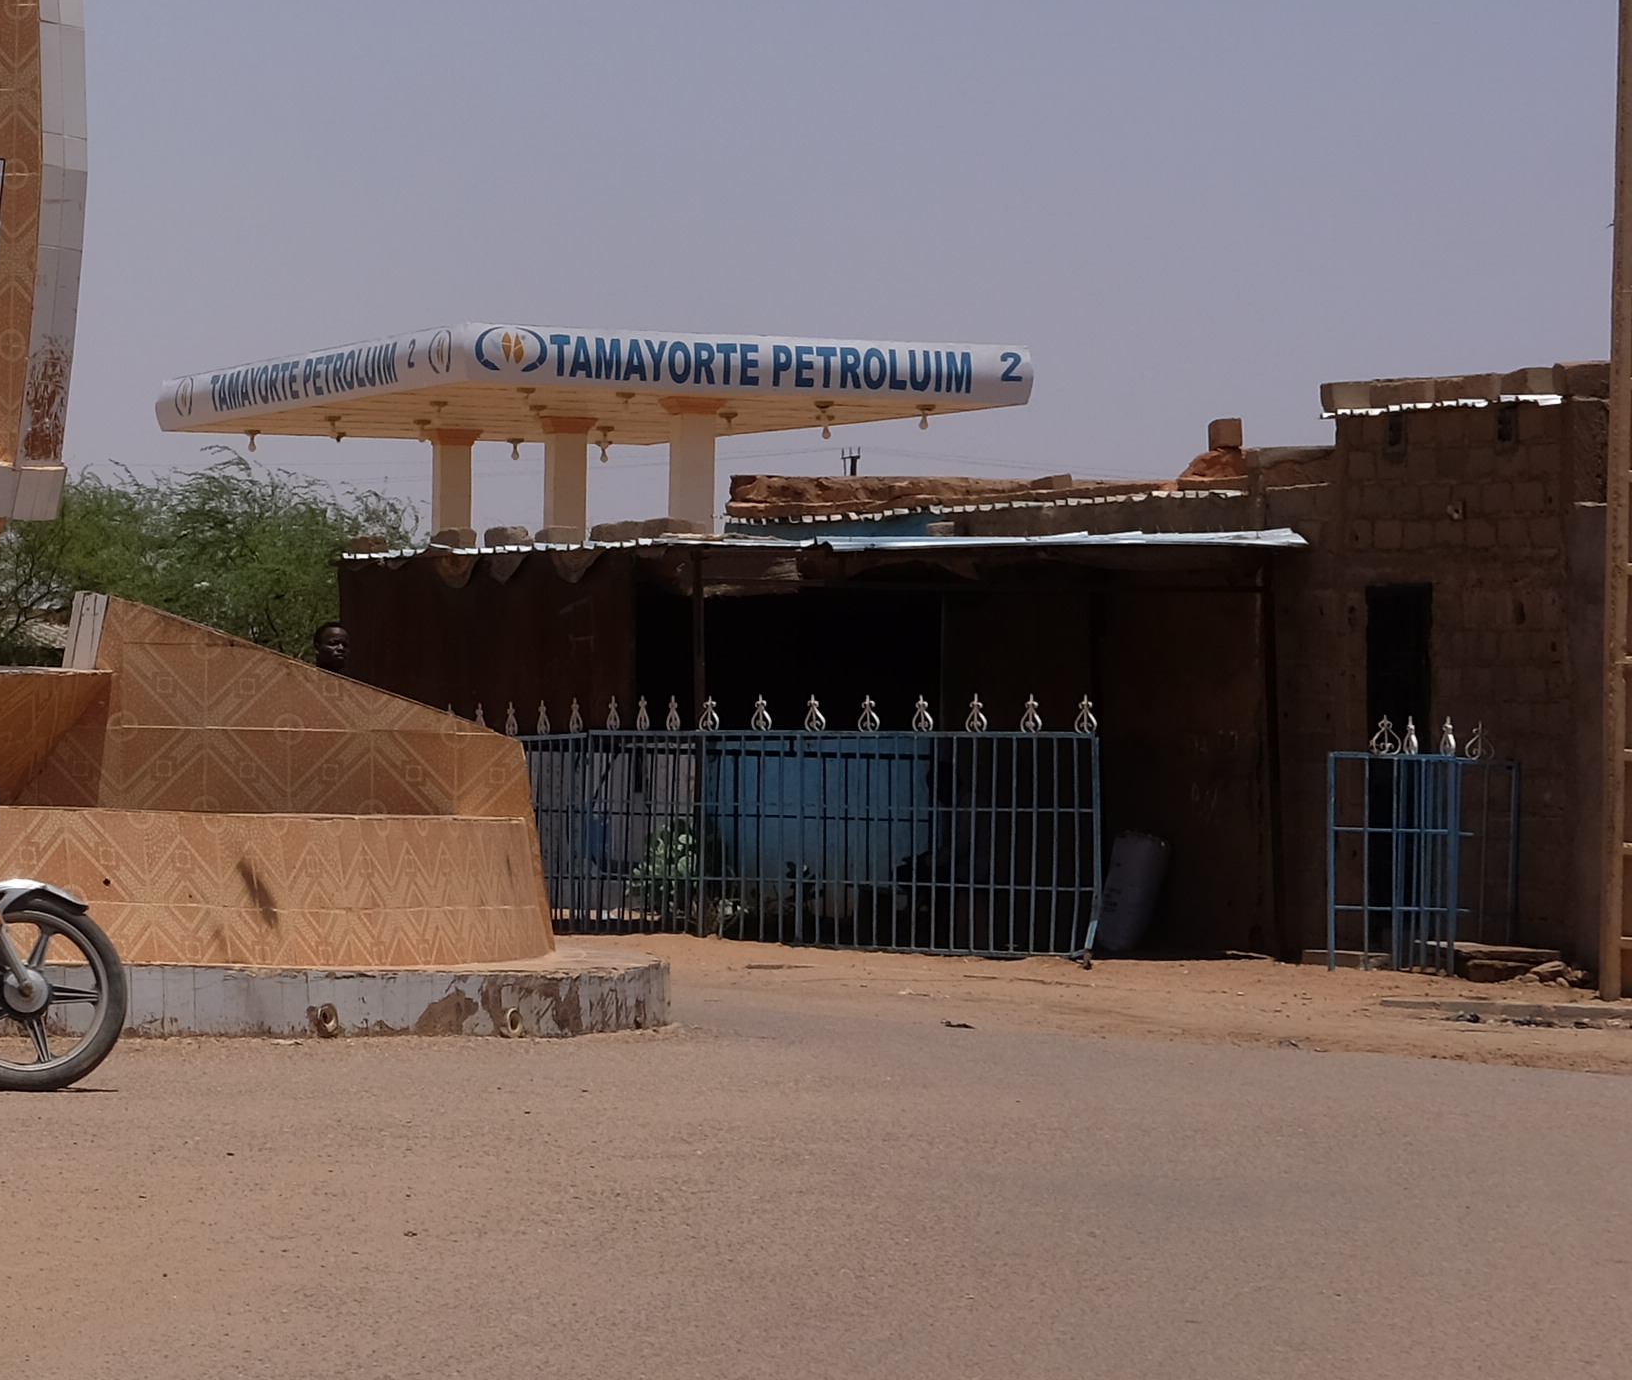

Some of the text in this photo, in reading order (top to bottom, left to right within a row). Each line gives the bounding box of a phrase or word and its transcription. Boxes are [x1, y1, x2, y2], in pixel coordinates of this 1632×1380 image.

[209, 338, 417, 413] TAMAYORTE PETROLUIM 2
[549, 334, 1023, 395] TAMAYORTE PETROLUIM 2
